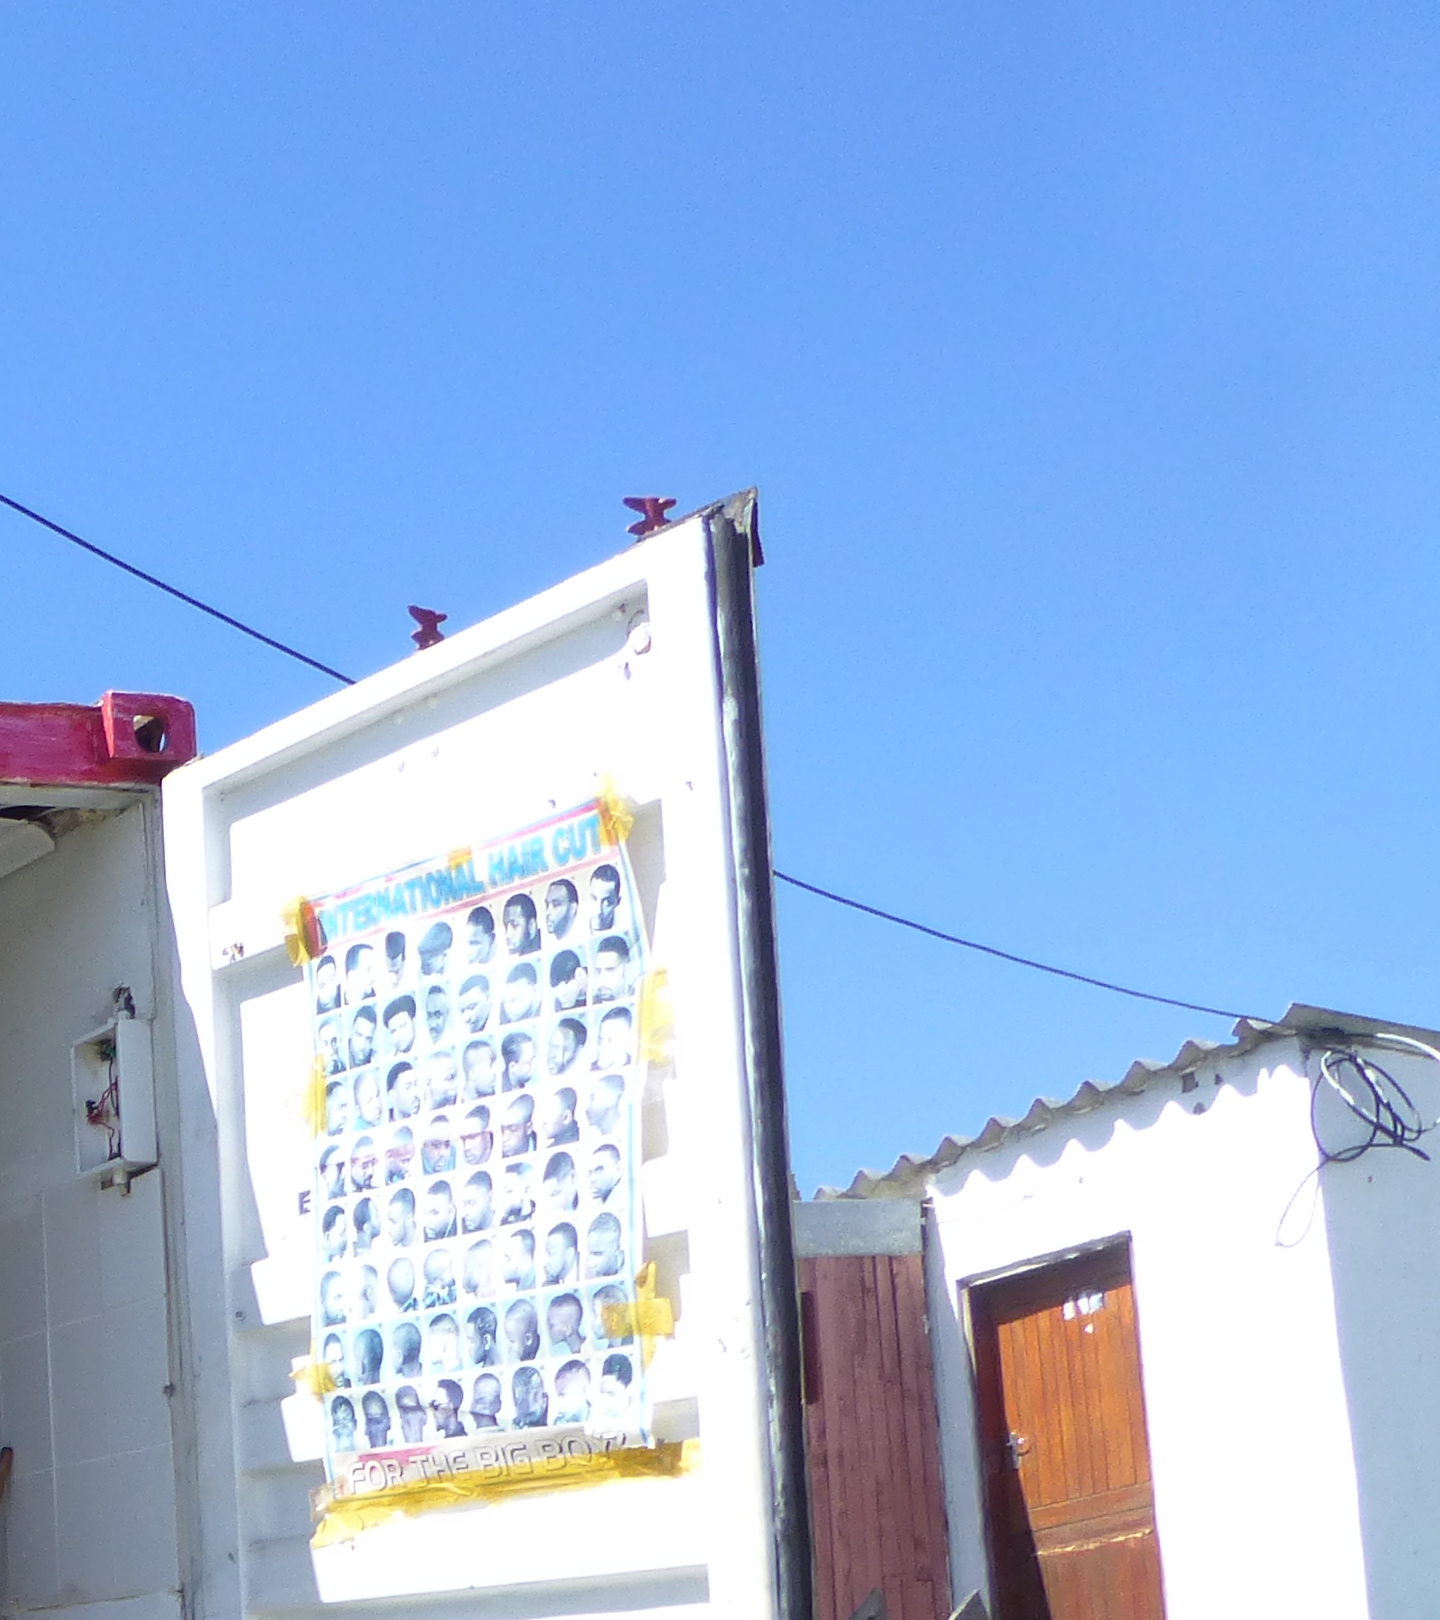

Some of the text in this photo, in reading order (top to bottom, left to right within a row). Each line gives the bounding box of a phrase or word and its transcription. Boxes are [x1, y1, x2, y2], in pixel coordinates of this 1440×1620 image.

[318, 814, 602, 942] INTERNATIONAL HAIR CUT
[347, 1460, 403, 1495] FOR
[409, 1453, 469, 1488] THE
[474, 1441, 532, 1481] BIG
